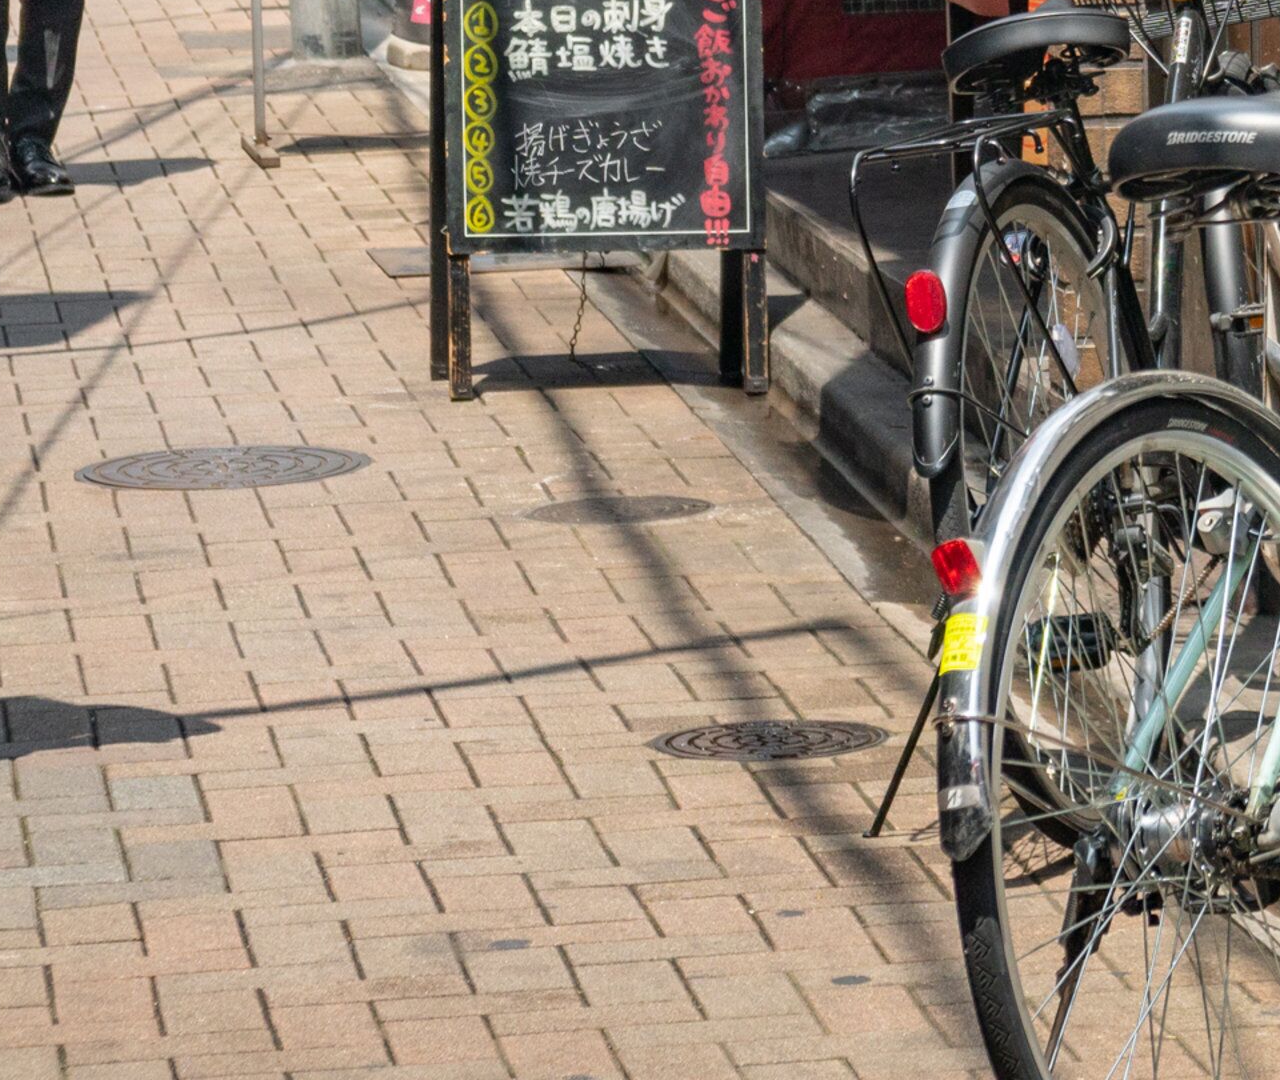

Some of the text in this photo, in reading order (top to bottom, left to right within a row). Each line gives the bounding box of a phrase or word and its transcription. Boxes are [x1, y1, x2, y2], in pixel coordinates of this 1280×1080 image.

[504, 35, 671, 82] 鯖塩焼き
[1166, 130, 1258, 146] BRIDGESTONE
[501, 187, 686, 232] 若鶏の唐揚げ
